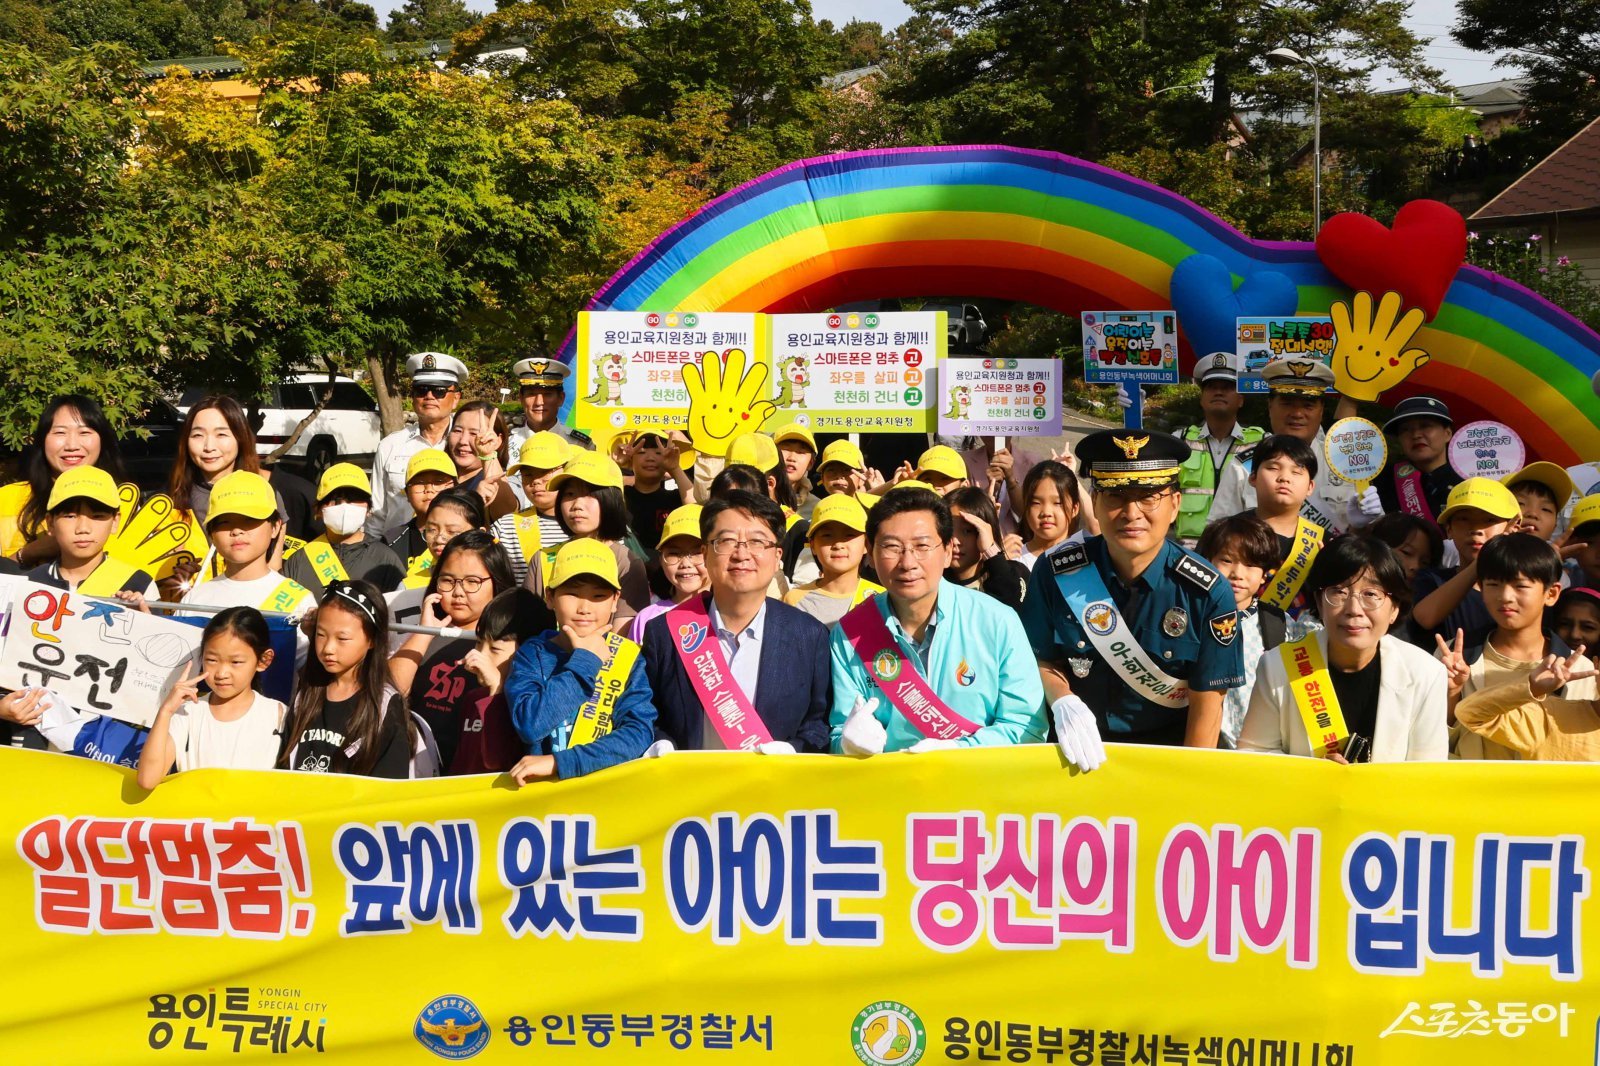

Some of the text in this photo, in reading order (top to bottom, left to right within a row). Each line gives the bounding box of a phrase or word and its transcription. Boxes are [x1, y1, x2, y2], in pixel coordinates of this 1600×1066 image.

[647, 316, 660, 325] GO
[684, 316, 697, 325] GO
[828, 317, 841, 325] GO
[865, 317, 878, 325] GO
[1103, 322, 1156, 338] 어린이는
[604, 330, 748, 346] 용인교육지원청과 함께!!
[787, 331, 929, 347] 용인교육지원청과 함께!!
[631, 351, 691, 364] 스마트폰은
[814, 352, 872, 365] 스마트폰은
[876, 352, 899, 365] 멈추
[830, 371, 866, 385] 좌우를
[874, 371, 898, 384] 살피
[956, 371, 1050, 381] 용인교육지원청과 함께!!
[1099, 371, 1173, 382] 용인동부녹색어머니회
[974, 384, 1013, 393] 스마트폰은
[651, 389, 688, 402] 천천히
[834, 390, 870, 404] 천천히
[875, 390, 899, 404] 건너
[984, 396, 1009, 405] 좌우를
[632, 415, 689, 425] 경기도용인교
[987, 409, 1011, 418] 천천히
[816, 417, 914, 427] 경기도용인교육지원청
[1348, 453, 1370, 467] NO!
[1476, 460, 1499, 470] NO!
[20, 814, 1583, 975] 일단멈춤! 앞에 있는 아이는 당신의 아이 입니다
[258, 987, 301, 998] YONGIN
[258, 1000, 328, 1013] SPECIAL CITY
[147, 987, 327, 1054] 용인특례시
[503, 1014, 774, 1051] 용인동부경찰서
